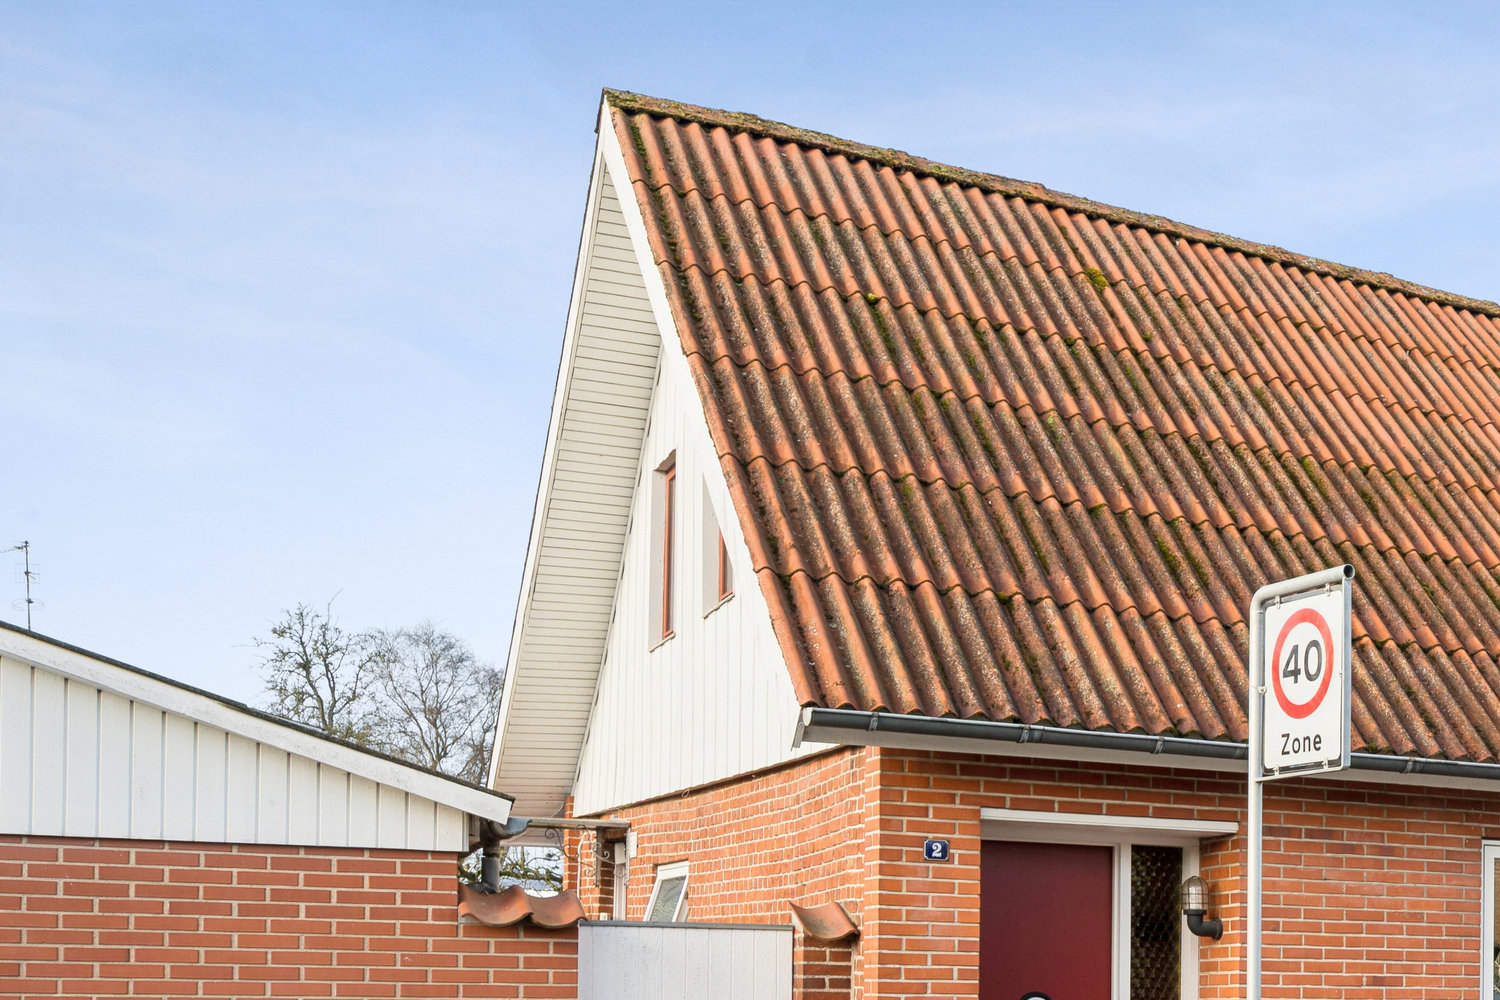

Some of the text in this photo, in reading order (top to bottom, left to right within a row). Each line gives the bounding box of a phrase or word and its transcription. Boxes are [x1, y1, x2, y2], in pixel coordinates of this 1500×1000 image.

[1282, 639, 1322, 684] 40
[1281, 733, 1322, 755] Zone
[931, 842, 942, 858] 2
